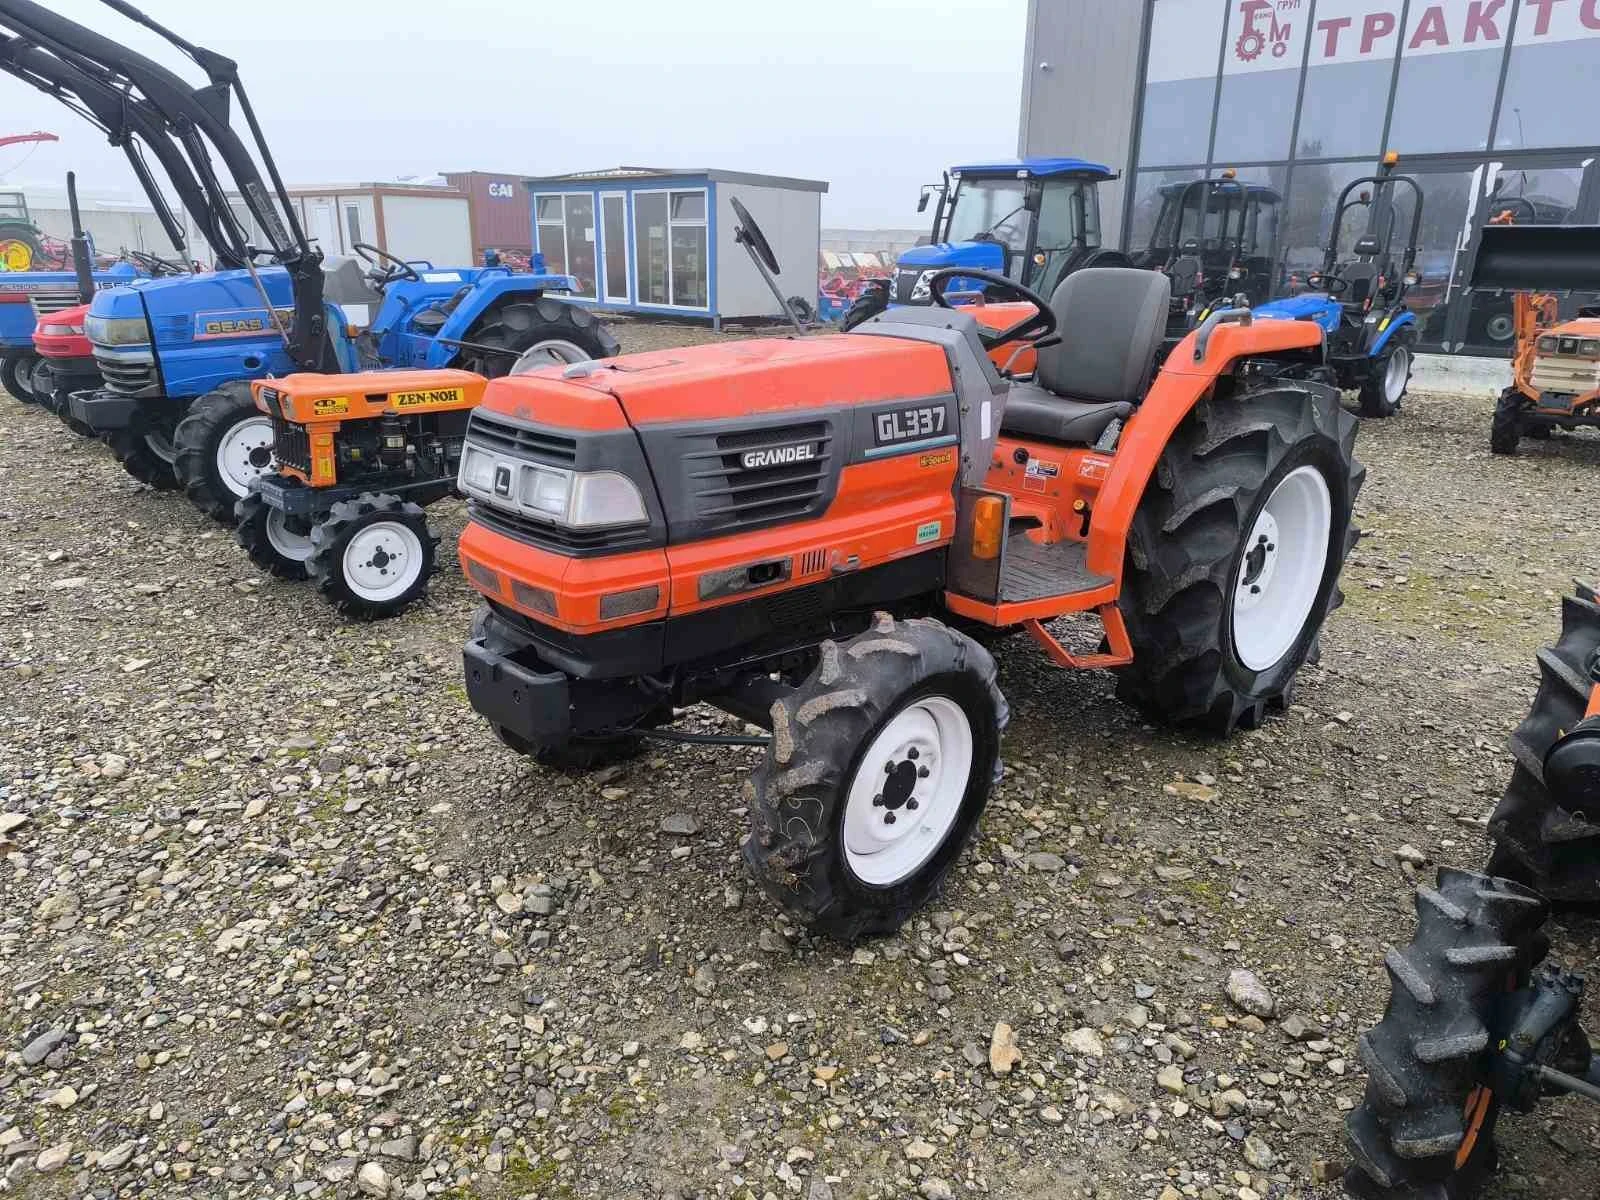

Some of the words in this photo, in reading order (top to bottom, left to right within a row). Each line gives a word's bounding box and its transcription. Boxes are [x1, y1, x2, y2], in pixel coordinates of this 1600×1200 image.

[398, 391, 457, 405] ZEN-NOH
[878, 407, 945, 440] GL337
[744, 445, 814, 467] GRANDEL
